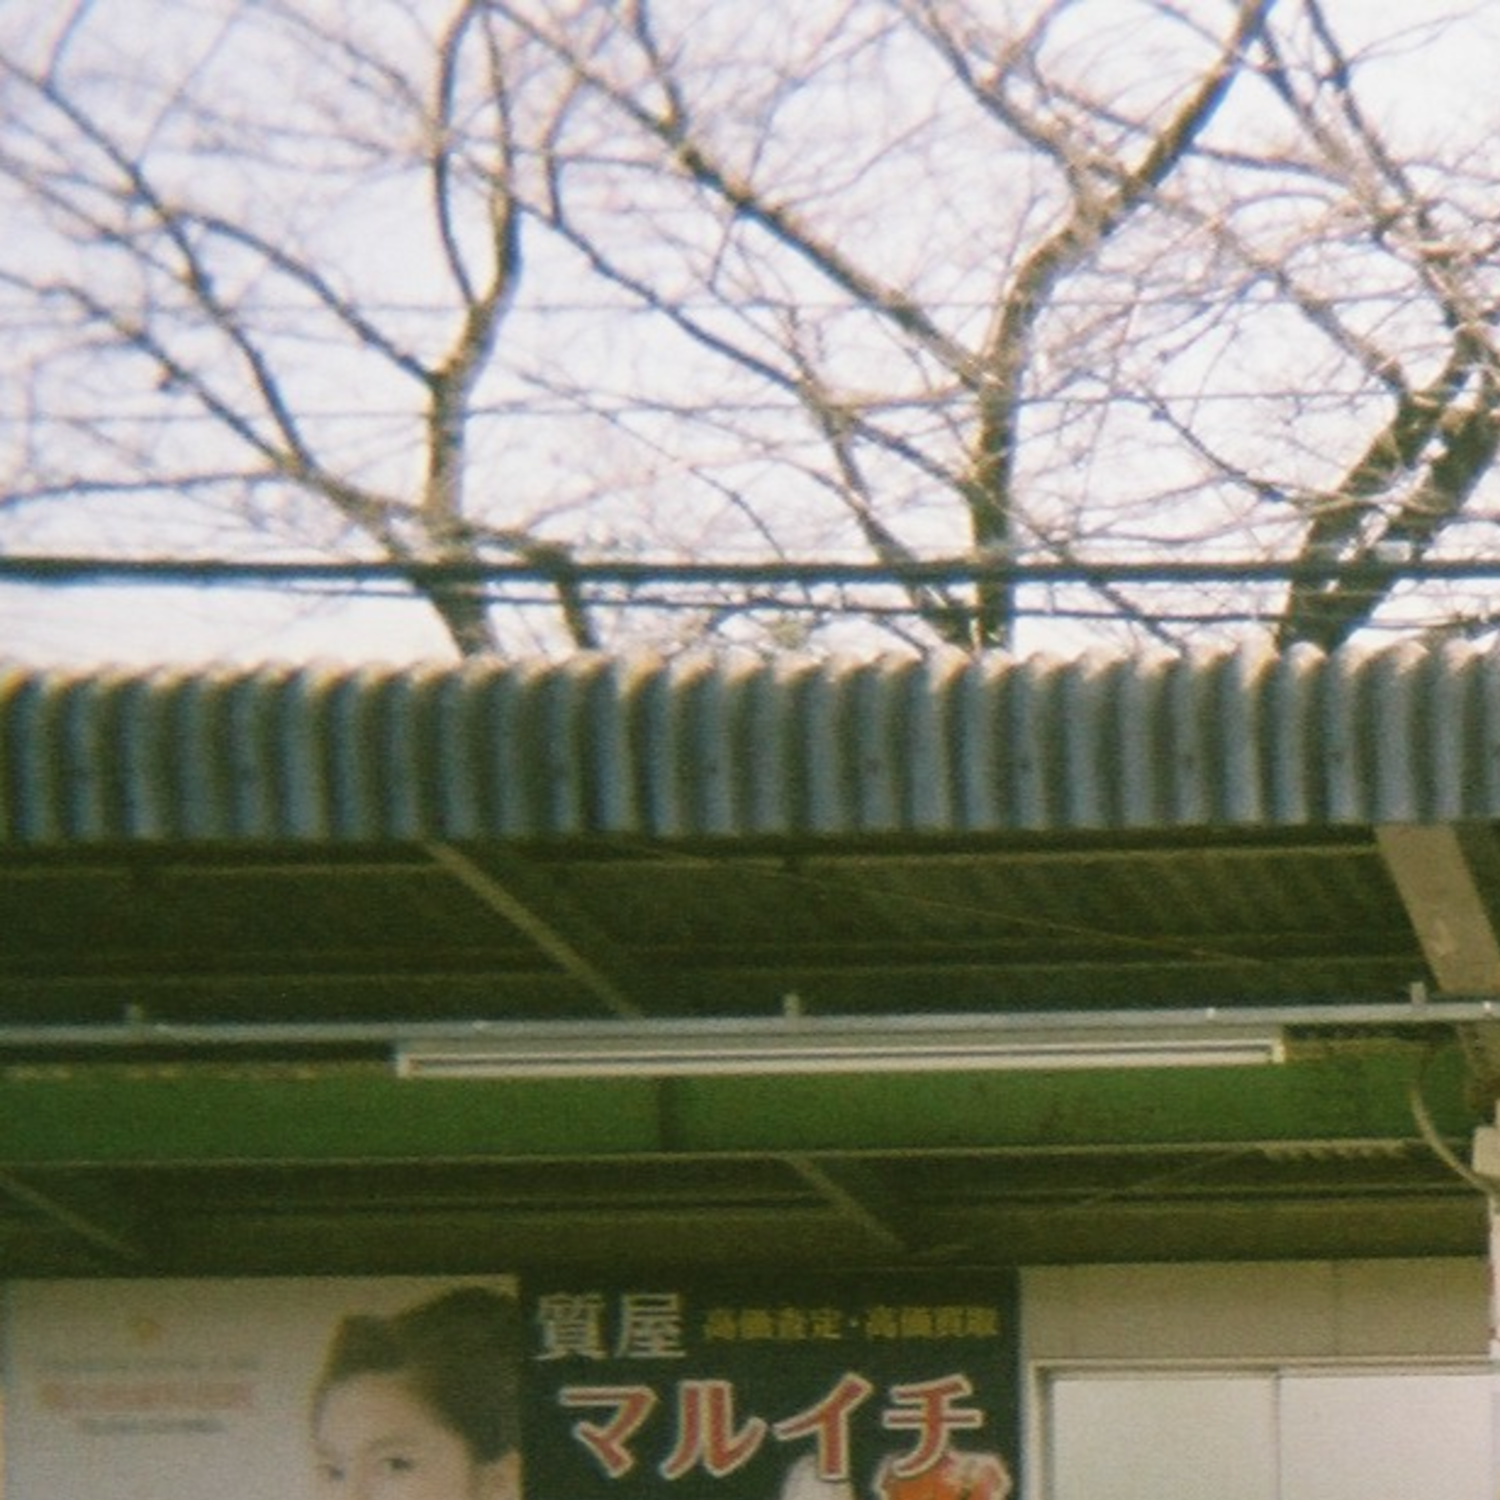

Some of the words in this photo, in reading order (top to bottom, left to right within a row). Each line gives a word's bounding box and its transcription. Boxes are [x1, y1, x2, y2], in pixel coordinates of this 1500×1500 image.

[536, 1293, 686, 1360] 質屋
[558, 1372, 983, 1481] マルイチ
